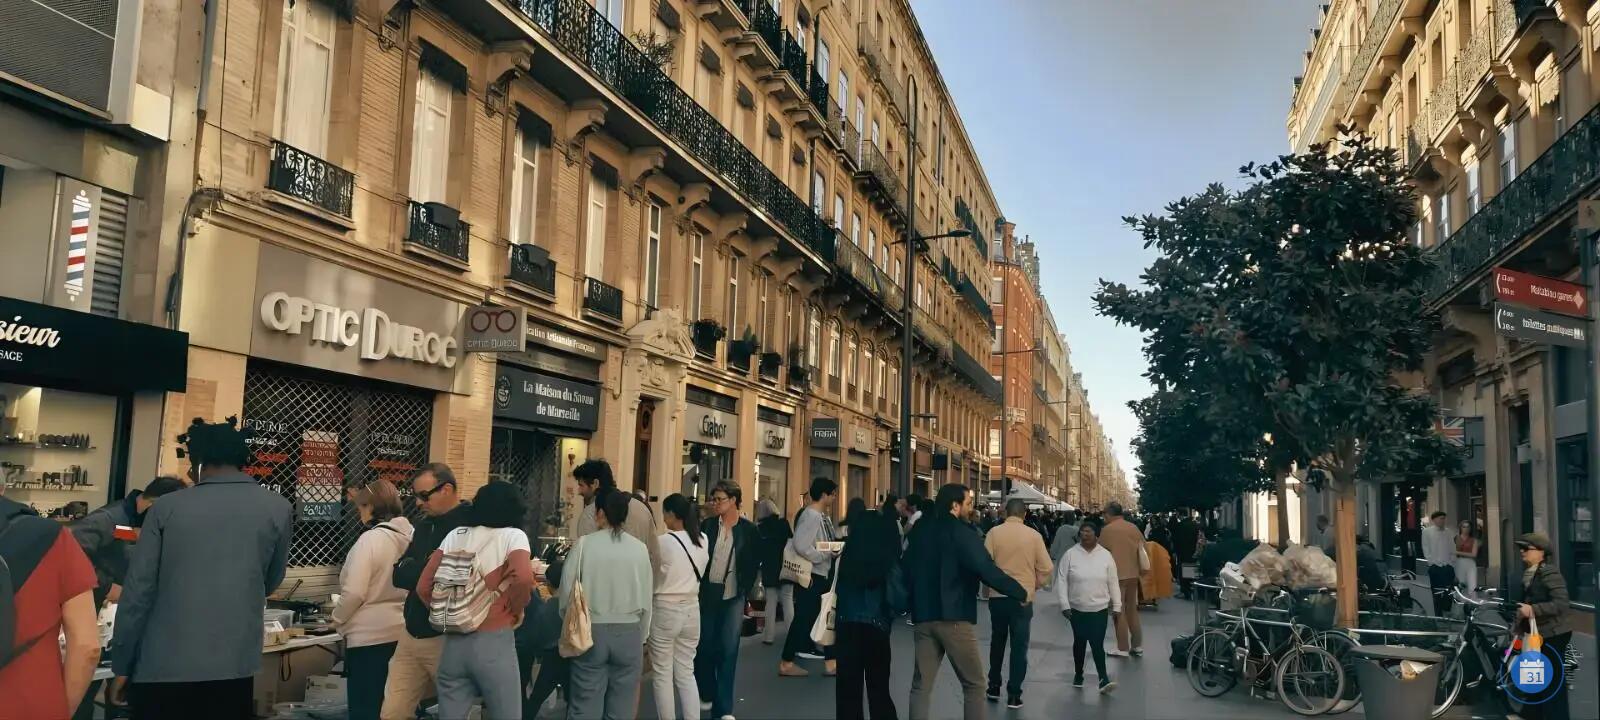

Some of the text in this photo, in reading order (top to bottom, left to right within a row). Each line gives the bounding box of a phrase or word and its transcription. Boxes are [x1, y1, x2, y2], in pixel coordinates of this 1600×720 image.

[260, 291, 456, 368] OPTIC DUROC
[523, 380, 534, 393] La
[535, 382, 562, 399] Maison
[562, 387, 573, 402] du
[536, 401, 580, 421] de Marseille
[701, 414, 727, 440] Gabor
[766, 429, 786, 450] Gabor
